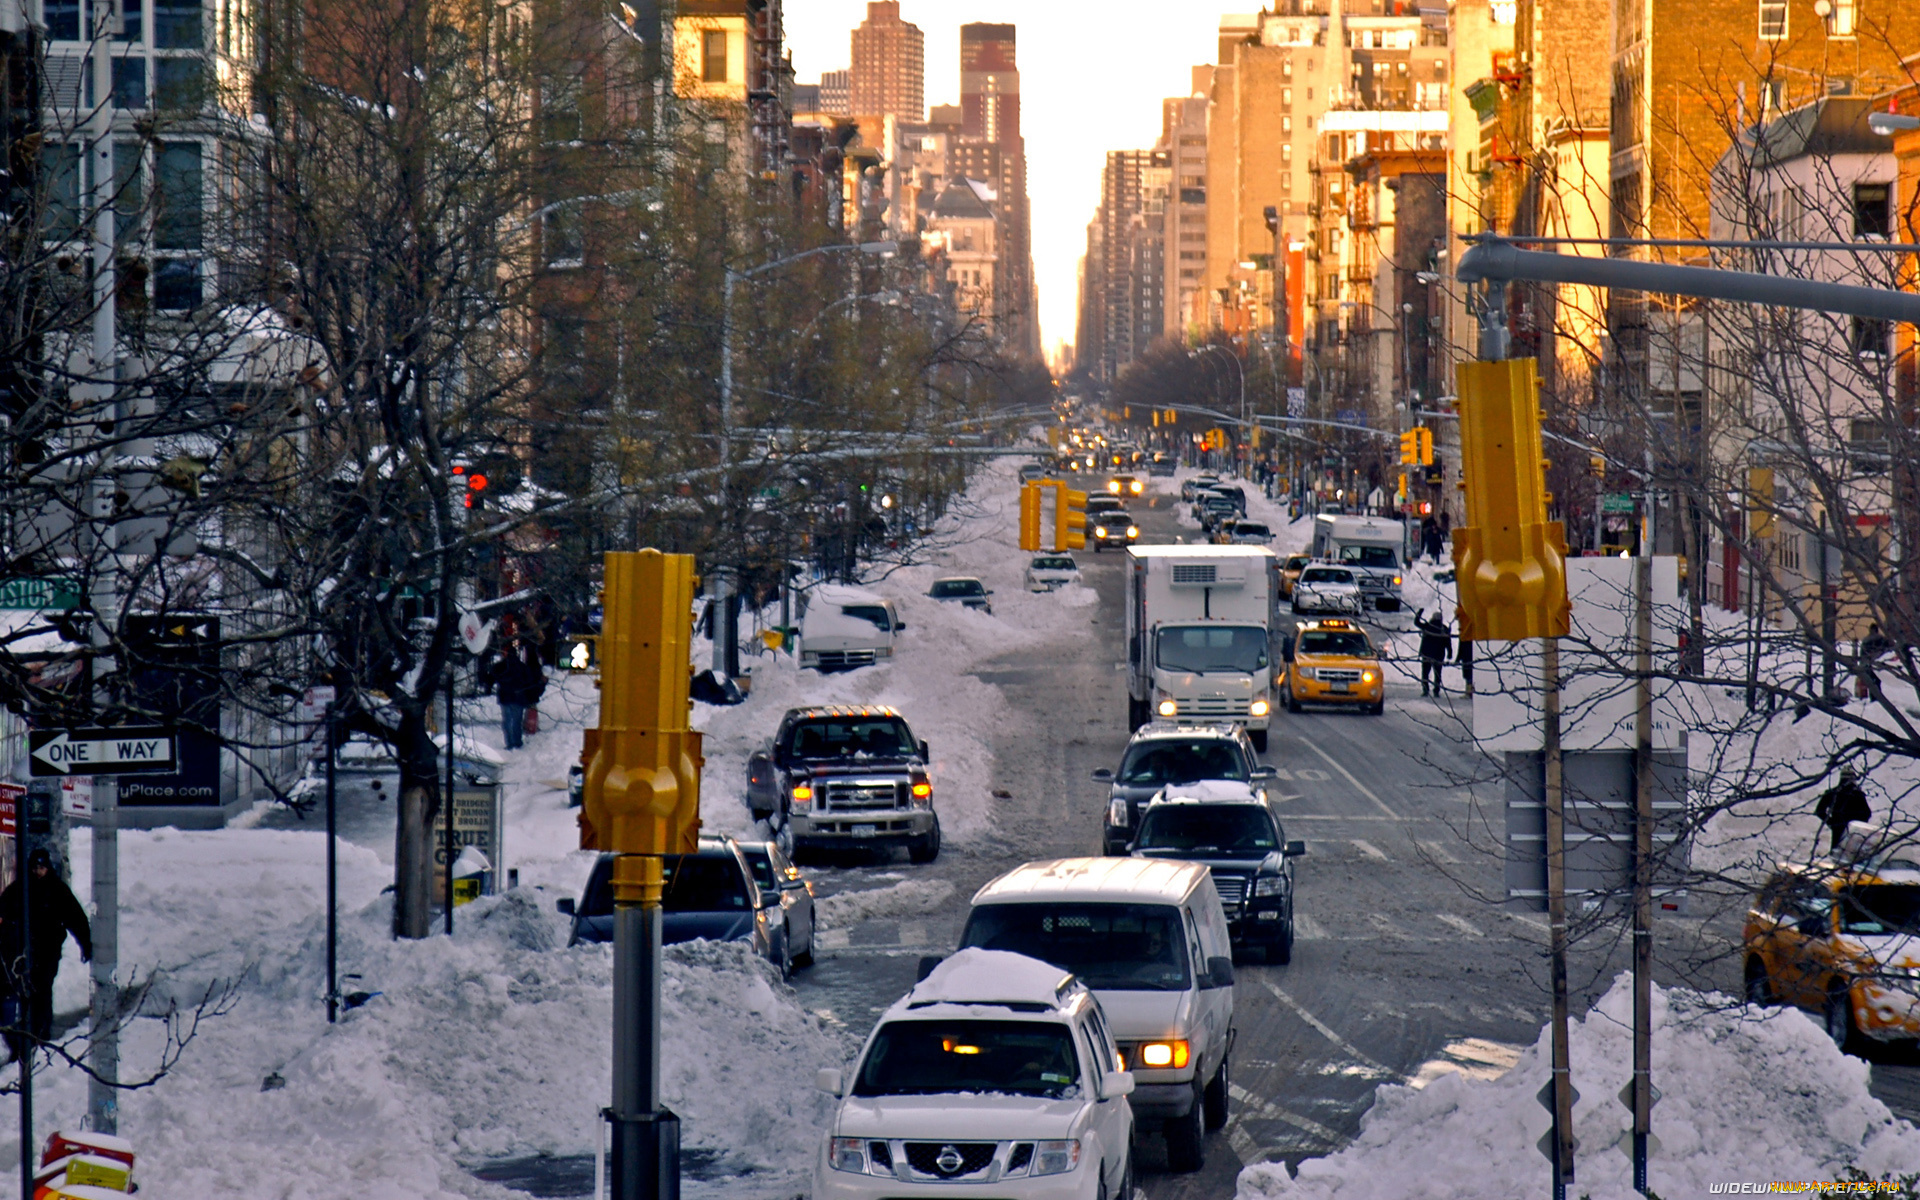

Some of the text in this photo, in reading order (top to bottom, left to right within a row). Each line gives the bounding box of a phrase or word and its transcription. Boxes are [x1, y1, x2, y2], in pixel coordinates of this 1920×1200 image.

[50, 741, 158, 761] ONE WAY
[118, 783, 212, 798] yPlace.com
[435, 829, 488, 846] TRUE
